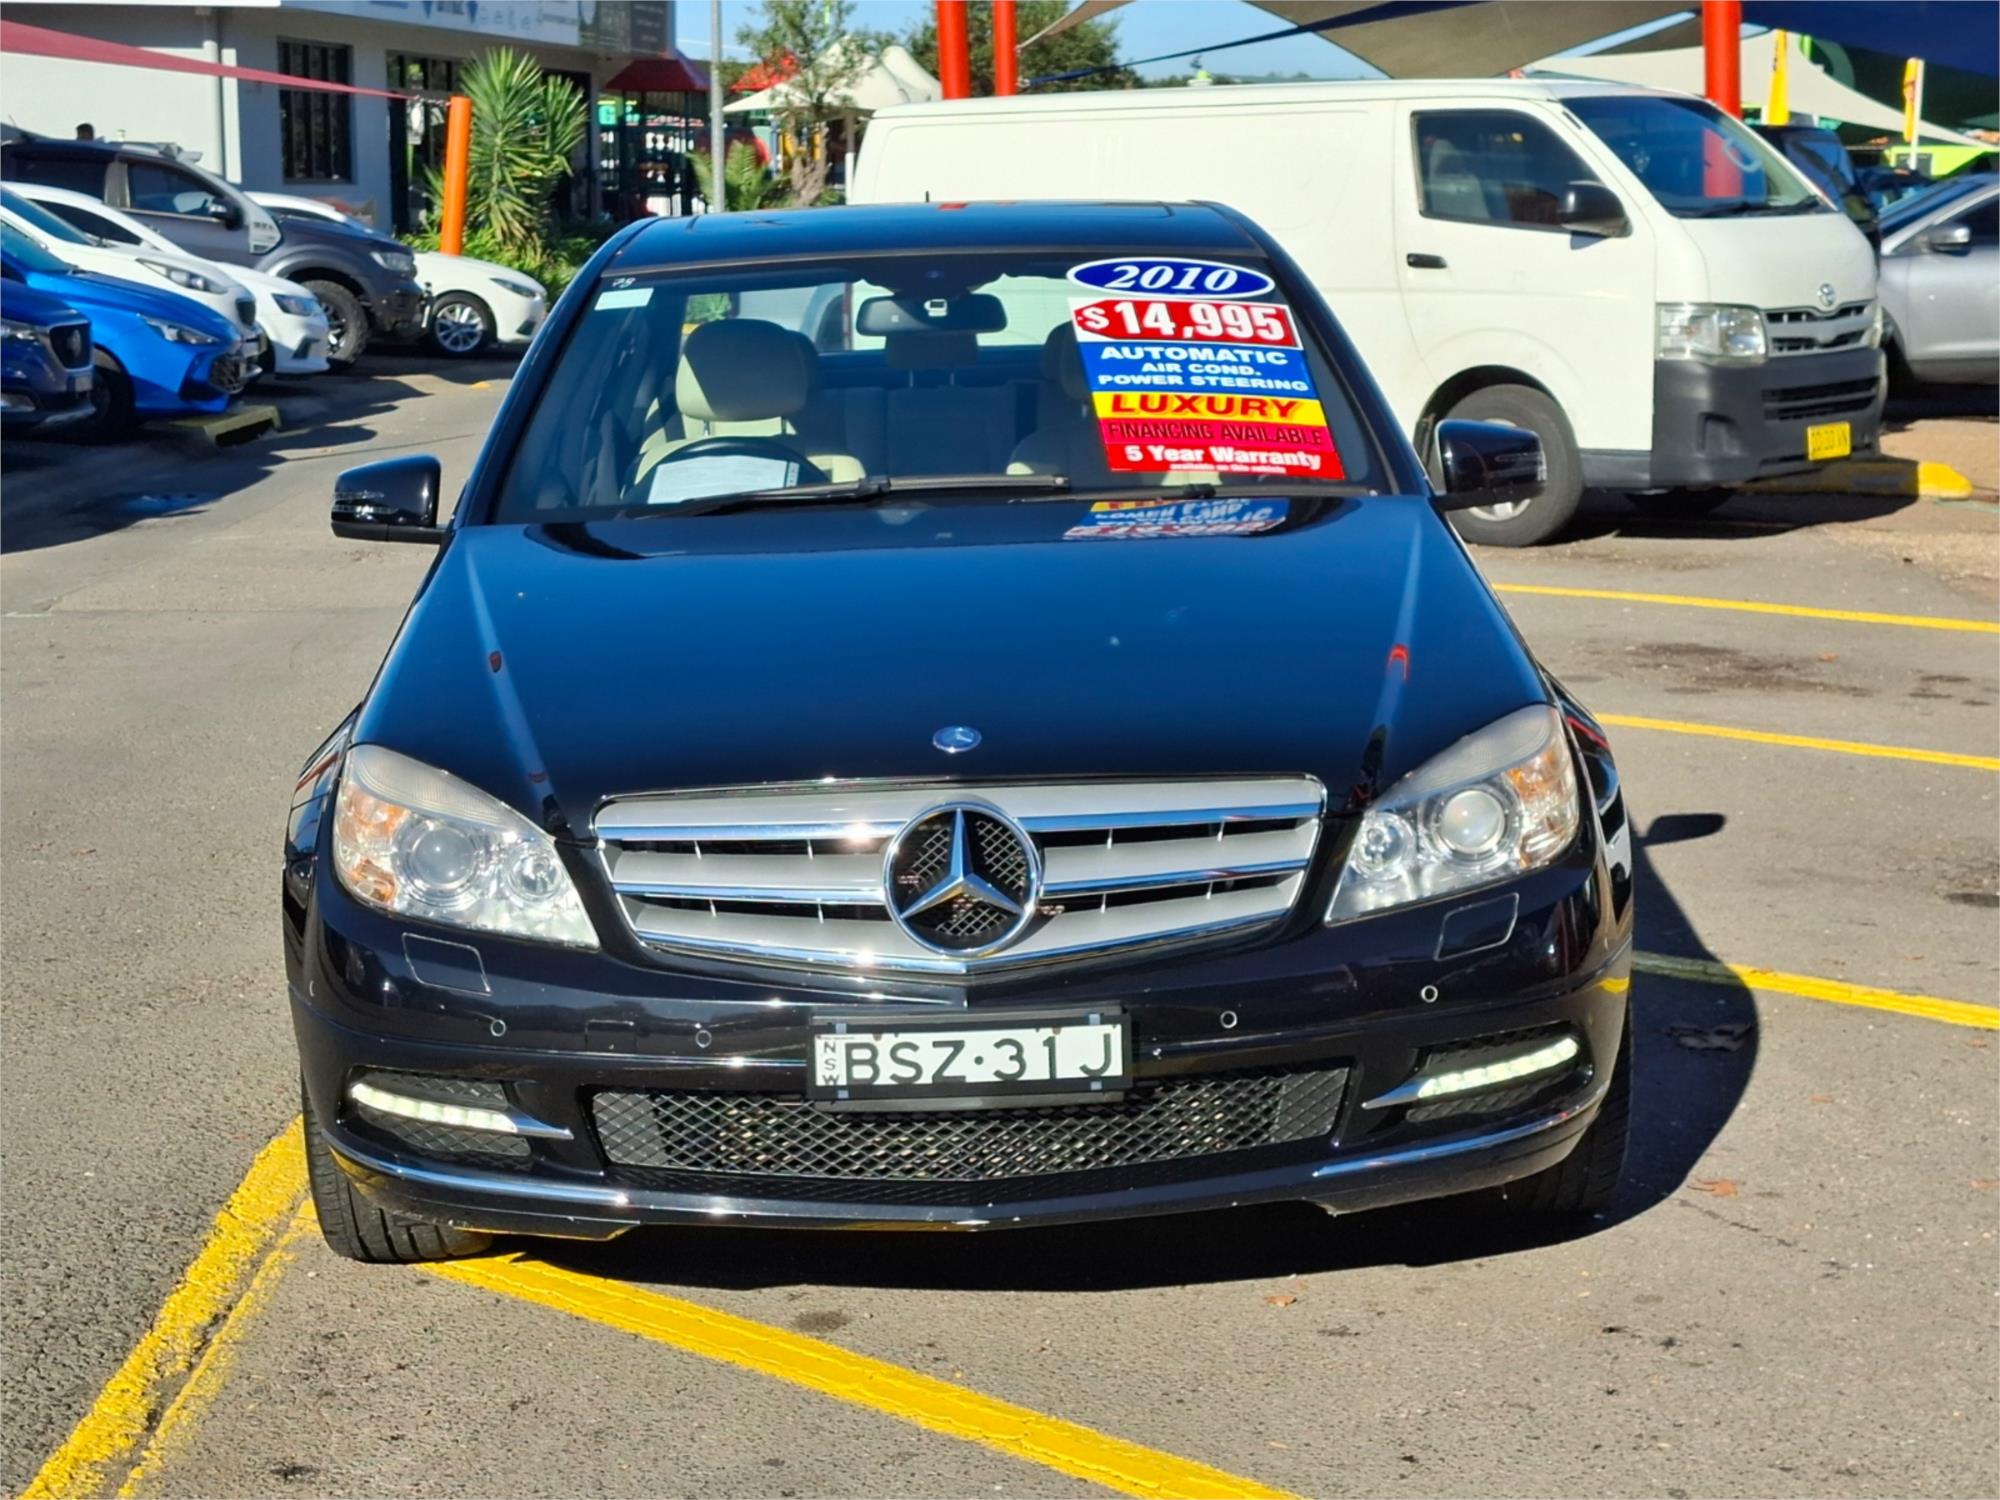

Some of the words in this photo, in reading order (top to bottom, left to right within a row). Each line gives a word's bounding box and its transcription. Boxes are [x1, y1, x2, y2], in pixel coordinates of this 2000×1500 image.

[1104, 265, 1238, 291] 2010
[1082, 301, 1285, 341] $14,995
[1101, 346, 1288, 365] AUTOMATIC
[1141, 362, 1182, 373] AIR
[1188, 363, 1262, 376] COND.
[1098, 375, 1184, 386] POWER
[1190, 376, 1309, 391] STEERING
[1111, 394, 1298, 418] LUXURY
[1108, 422, 1214, 440] FINANCING
[1221, 426, 1322, 445] AVAILABLE
[1147, 445, 1204, 462] Year
[1209, 446, 1321, 470] Warranty
